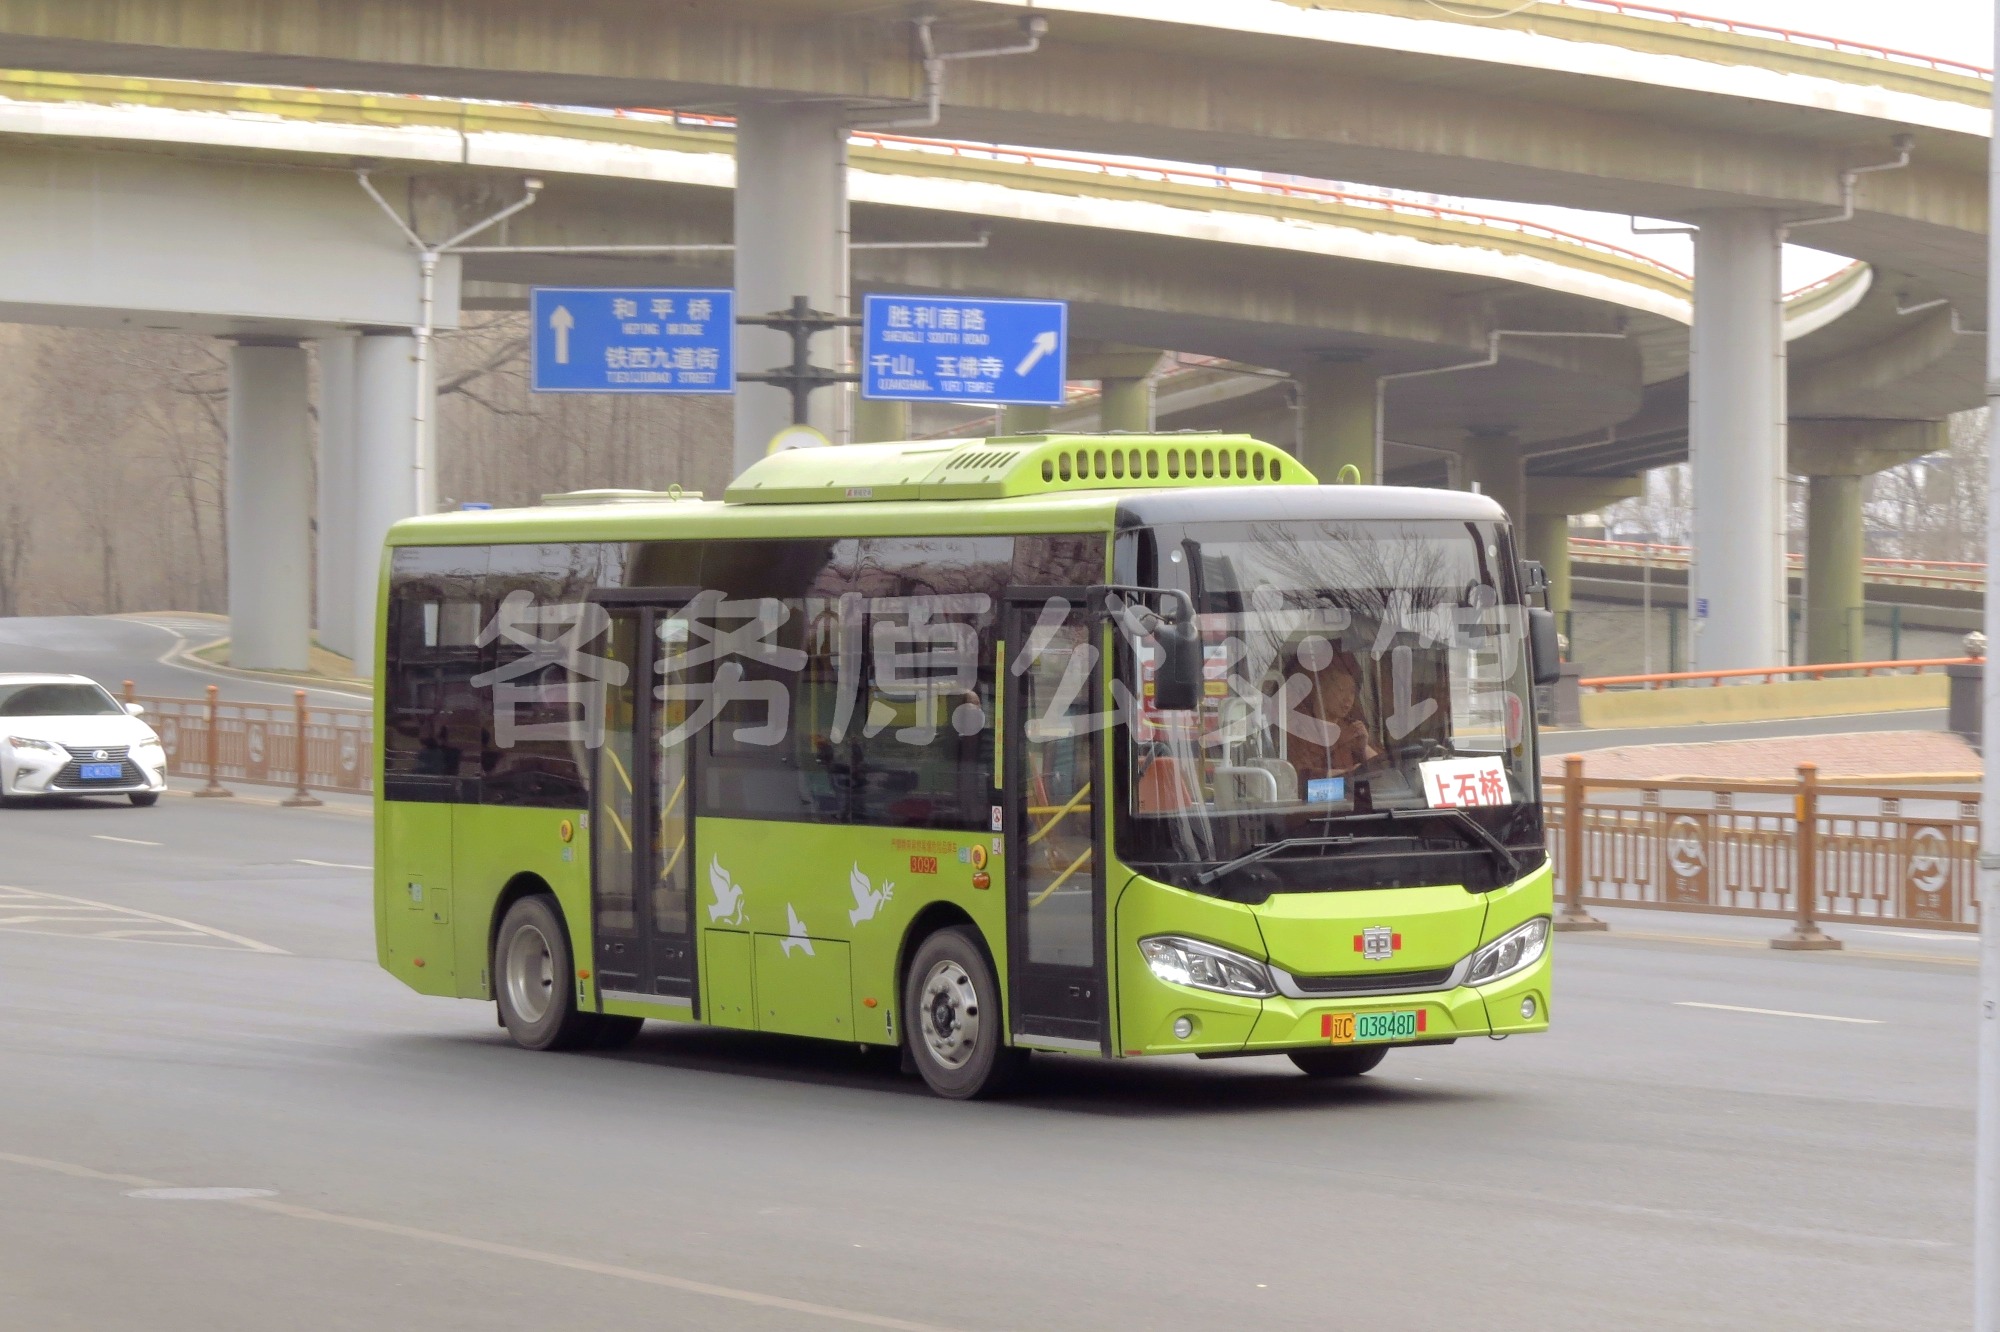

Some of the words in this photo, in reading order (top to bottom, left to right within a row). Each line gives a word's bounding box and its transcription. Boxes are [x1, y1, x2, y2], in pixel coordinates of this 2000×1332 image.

[612, 298, 712, 321] 和平桥
[887, 305, 986, 331] 胜利南路
[926, 332, 960, 344] SOUTH
[962, 332, 991, 346] ROAD
[605, 346, 720, 370] 铁西九道街
[1433, 769, 1504, 809] 上石桥
[911, 856, 937, 873] 3092
[1359, 1014, 1415, 1037] 03848D
